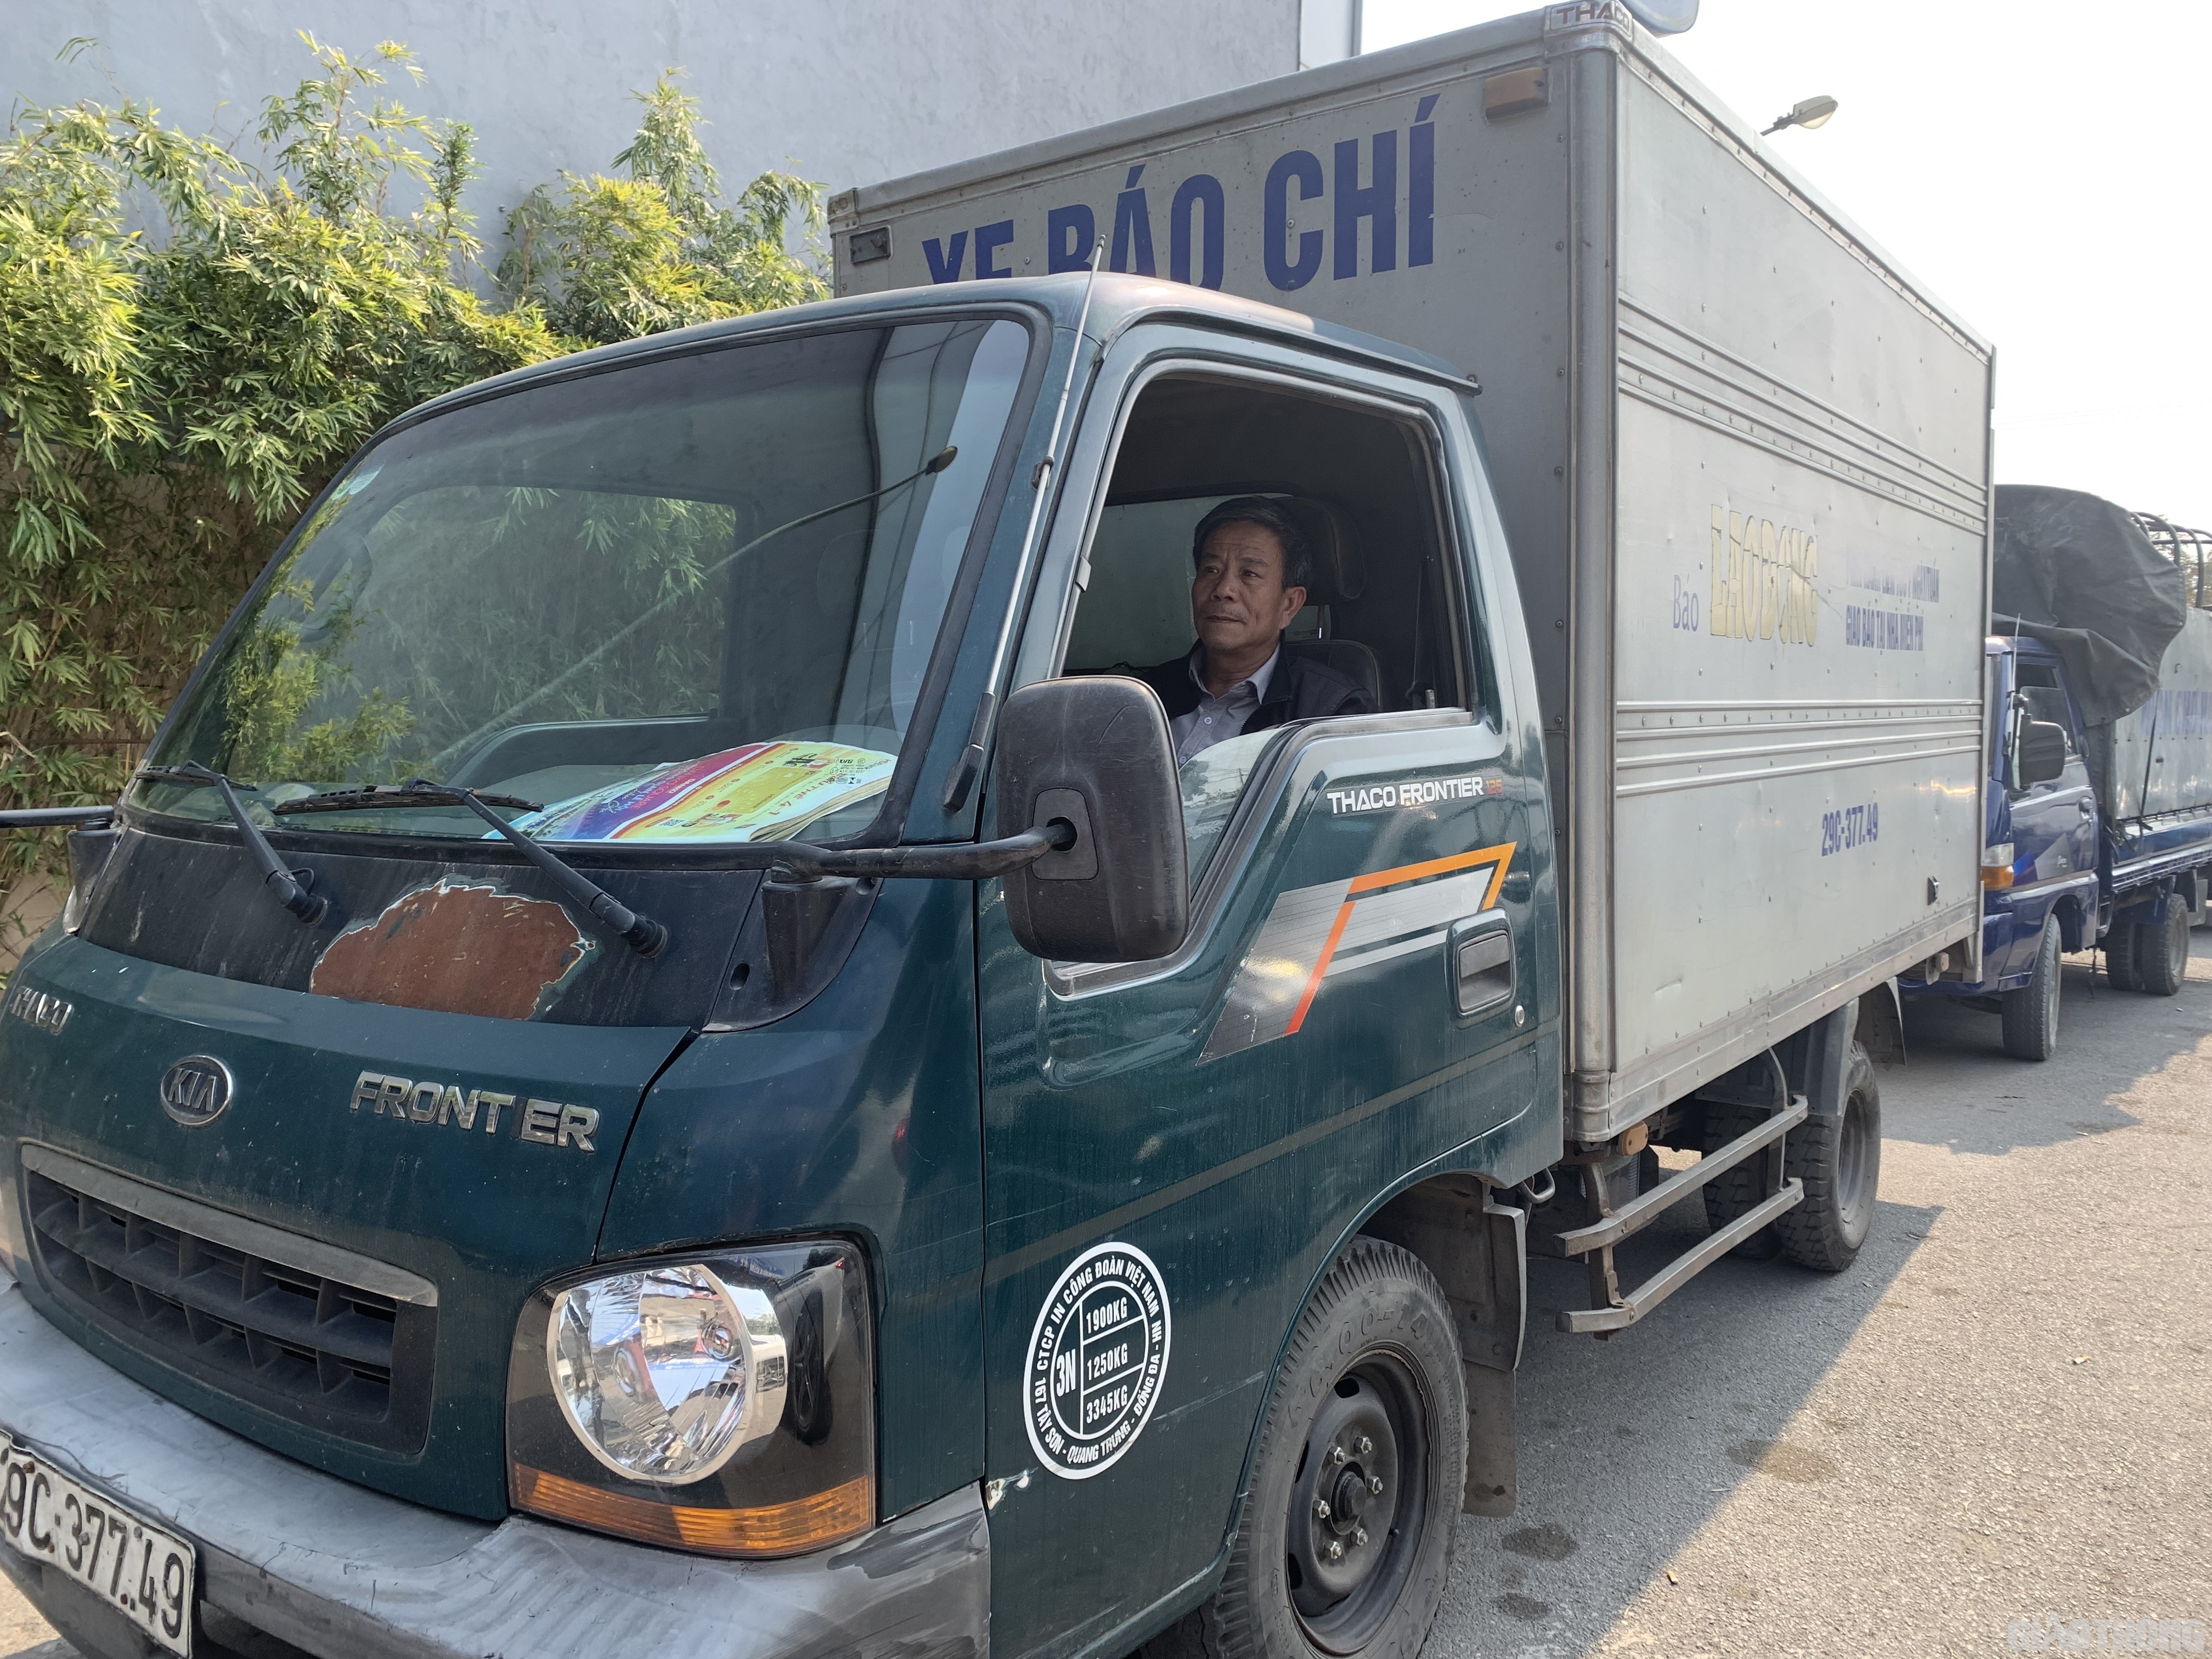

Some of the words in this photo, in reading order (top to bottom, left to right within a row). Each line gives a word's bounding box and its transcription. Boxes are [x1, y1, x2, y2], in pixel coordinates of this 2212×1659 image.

[1556, 2, 1629, 30] THACO
[1048, 164, 1224, 291] BÁO
[1263, 93, 1441, 291] CHÍ
[1673, 573, 1699, 632] Báo
[1327, 786, 1396, 814] THACO
[1399, 776, 1484, 806] FRONTIER
[1485, 778, 1503, 794] 125
[1821, 802, 1878, 856] 29C-377.49
[168, 1068, 217, 1111] KIA
[1037, 1325, 1054, 1370] CTCP
[1050, 1302, 1065, 1324] IN
[1063, 1267, 1093, 1304] CÔNG
[1095, 1255, 1124, 1279] ĐOÀN
[1125, 1261, 1146, 1288] VIỆT
[1141, 1281, 1159, 1317] NAM
[1086, 1297, 1127, 1334] 1900KG
[1152, 1320, 1162, 1343] HN
[1056, 1349, 1076, 1397] 3N
[1087, 1343, 1128, 1380] 1250KG
[1148, 1354, 1160, 1374] ĐA
[1035, 1377, 1047, 1403] 167
[1086, 1385, 1128, 1423] 3345KG
[1133, 1376, 1155, 1417] ĐỐNG
[1037, 1403, 1053, 1432] TÂY
[1045, 1427, 1065, 1454] SƠN
[1066, 1444, 1099, 1464] QUANG
[1100, 1420, 1131, 1457] TRUNG
